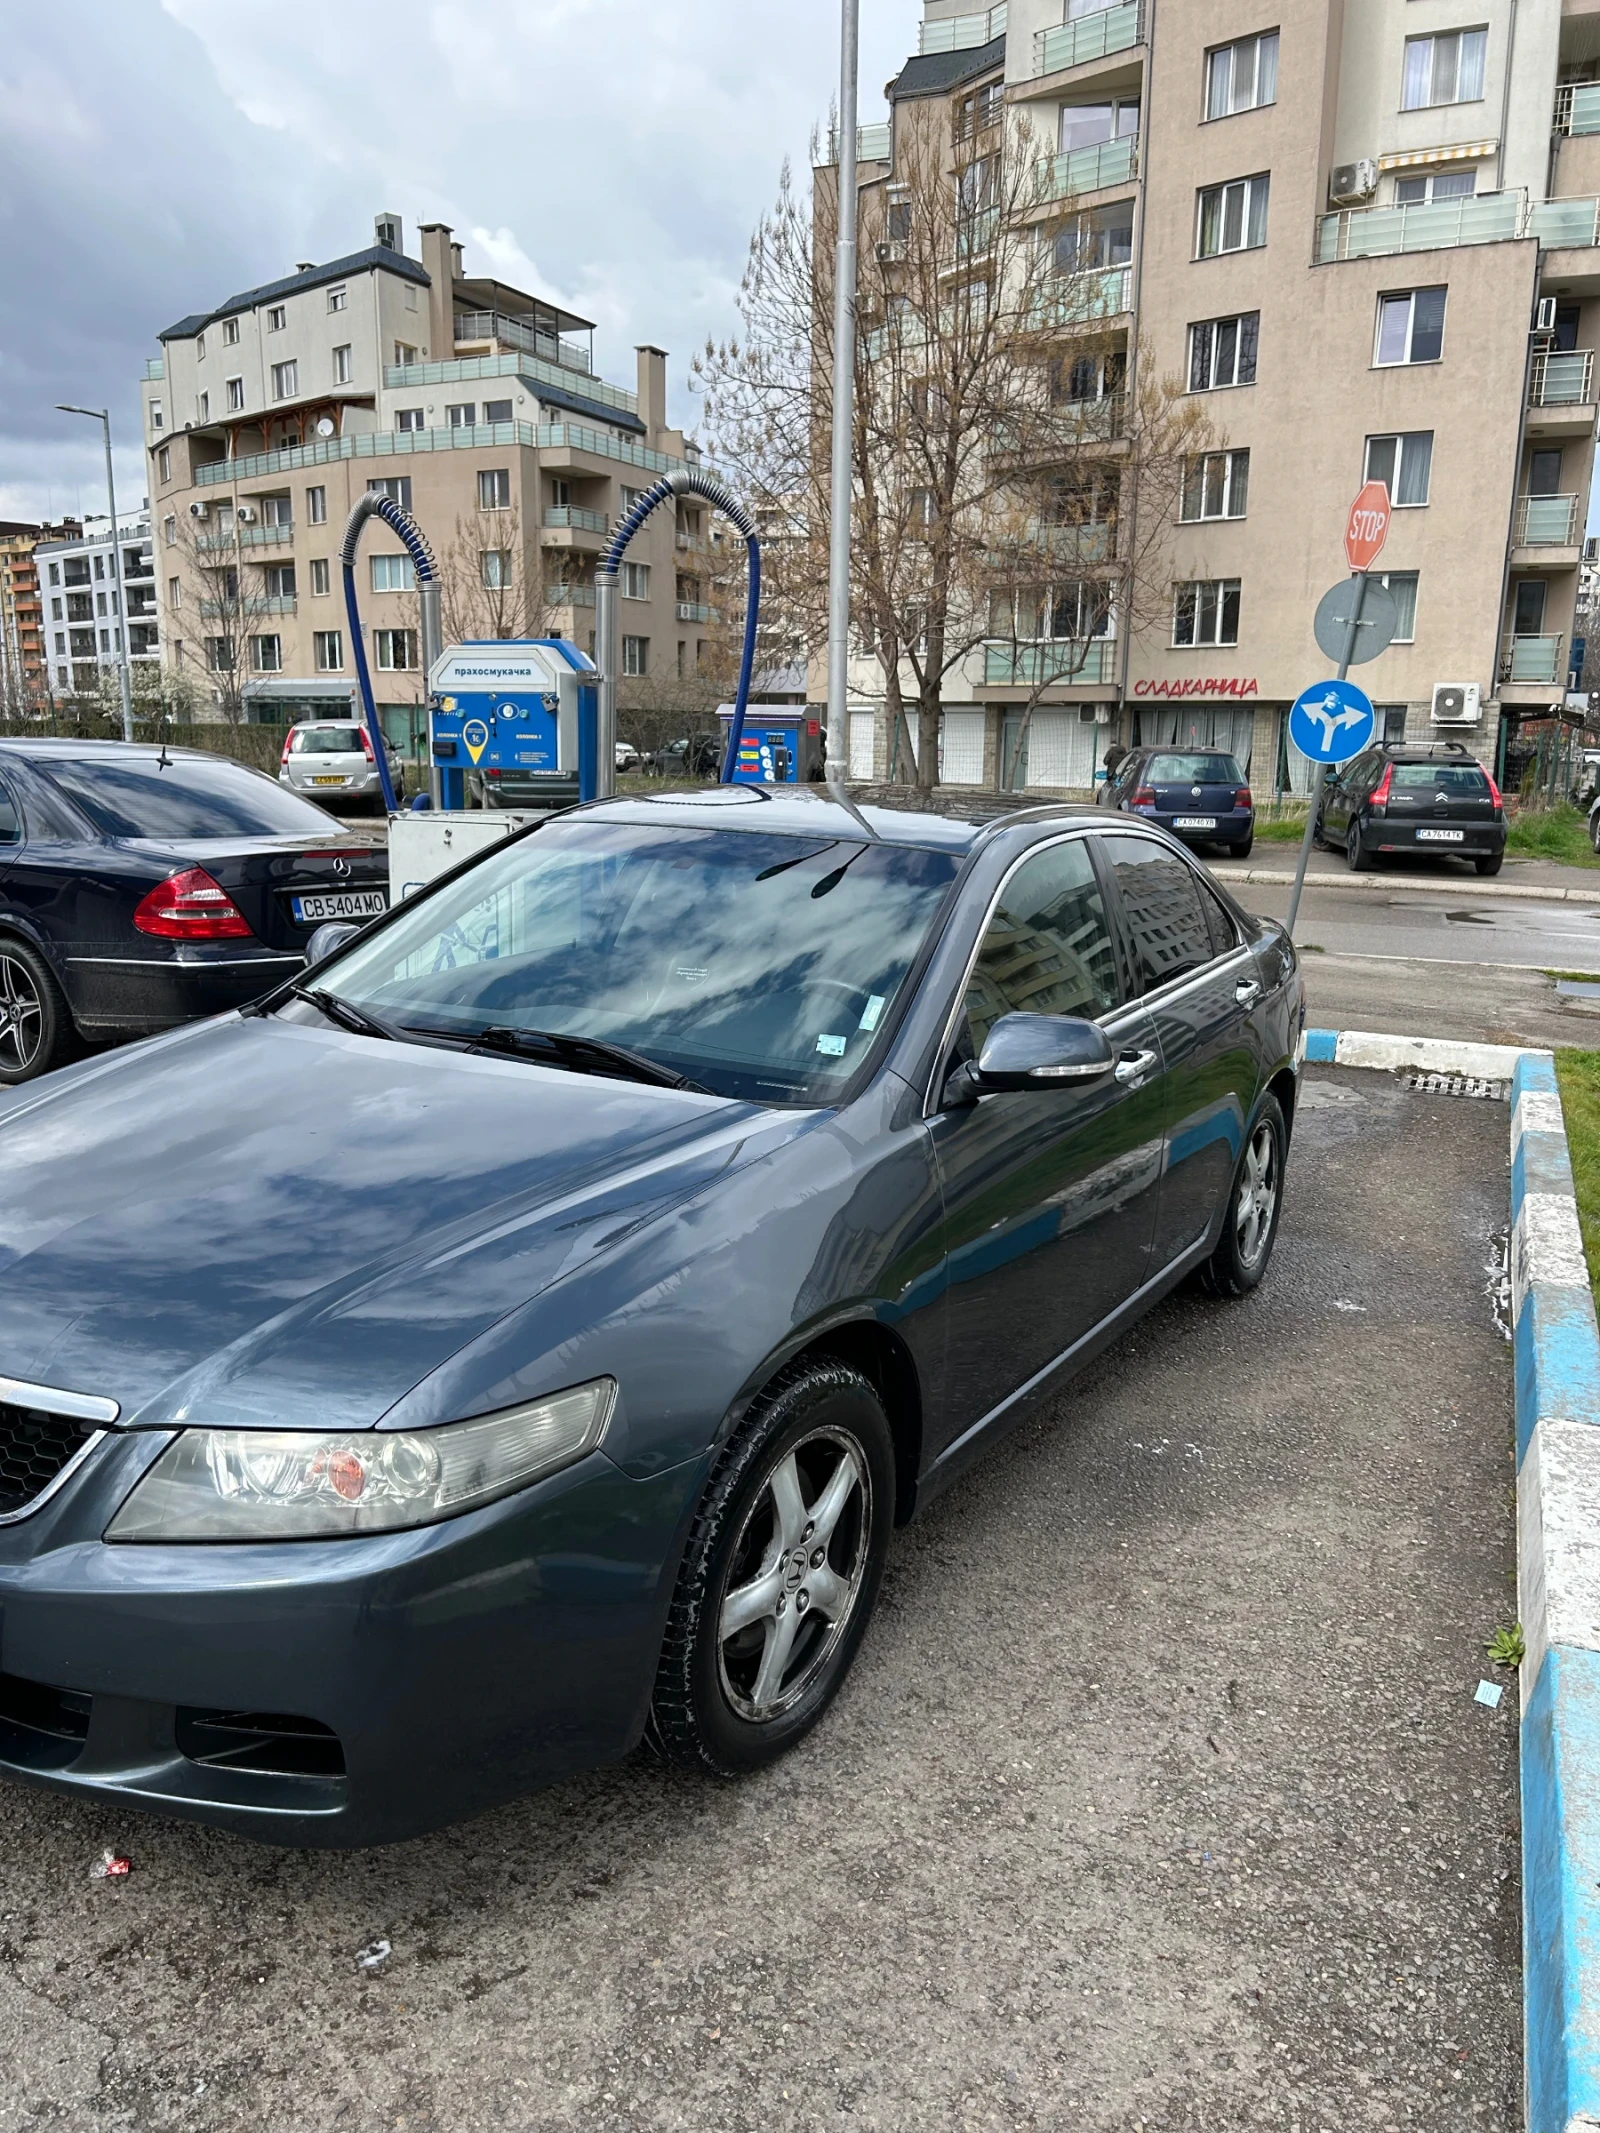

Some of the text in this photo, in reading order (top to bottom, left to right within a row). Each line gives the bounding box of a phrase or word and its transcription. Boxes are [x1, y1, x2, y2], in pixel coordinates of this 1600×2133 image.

[1350, 510, 1385, 542] STOP
[454, 668, 532, 677] прахосмукачка
[1134, 678, 1258, 699] СЛАДКАРНИЦА
[304, 894, 383, 918] CB 5404 MO
